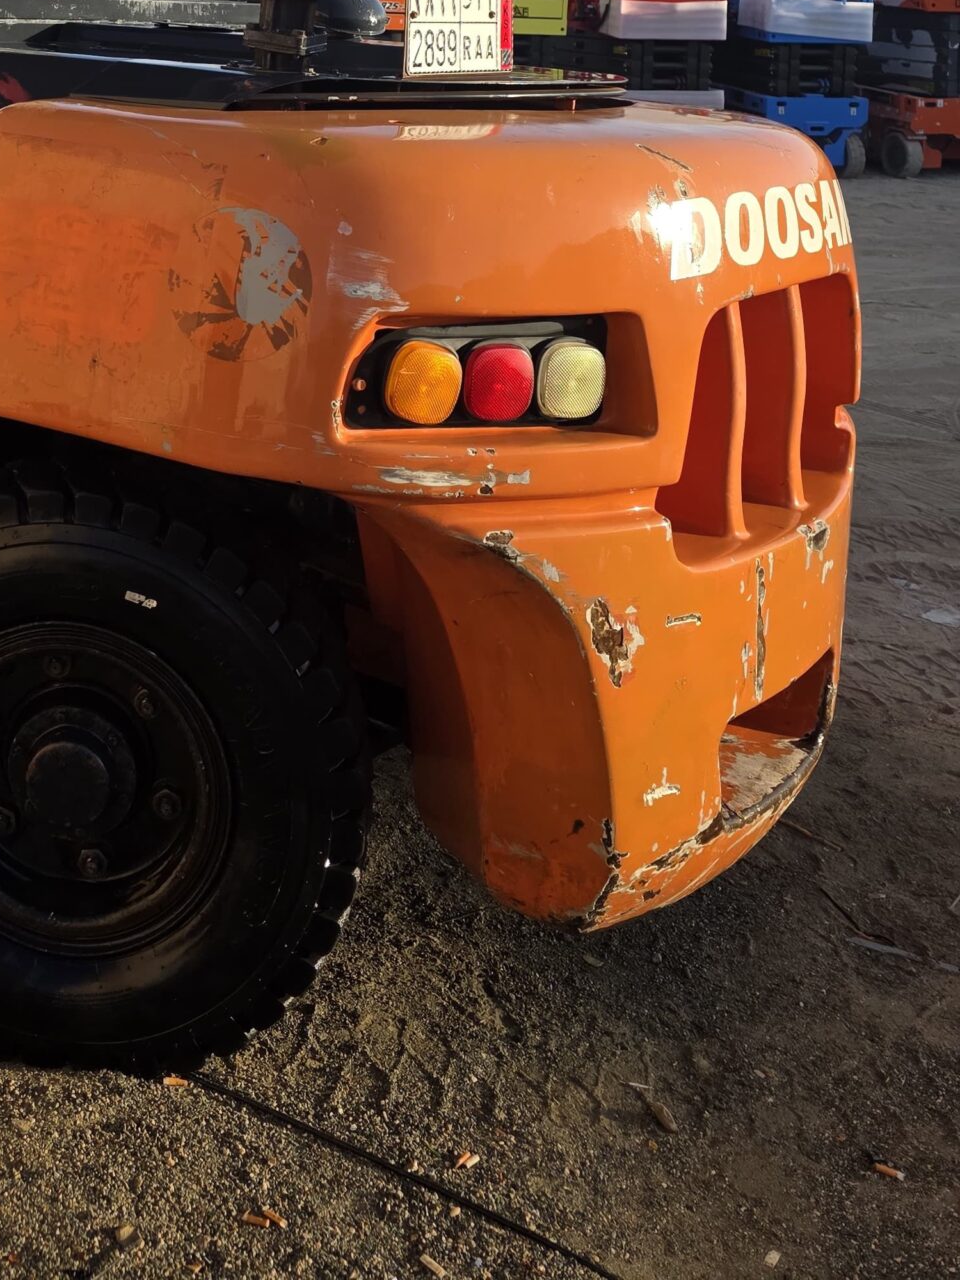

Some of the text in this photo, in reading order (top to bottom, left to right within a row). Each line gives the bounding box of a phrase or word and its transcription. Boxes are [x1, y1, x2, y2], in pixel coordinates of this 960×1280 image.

[412, 29, 494, 68] 2899 RAA
[668, 179, 853, 281] DOOSAN
